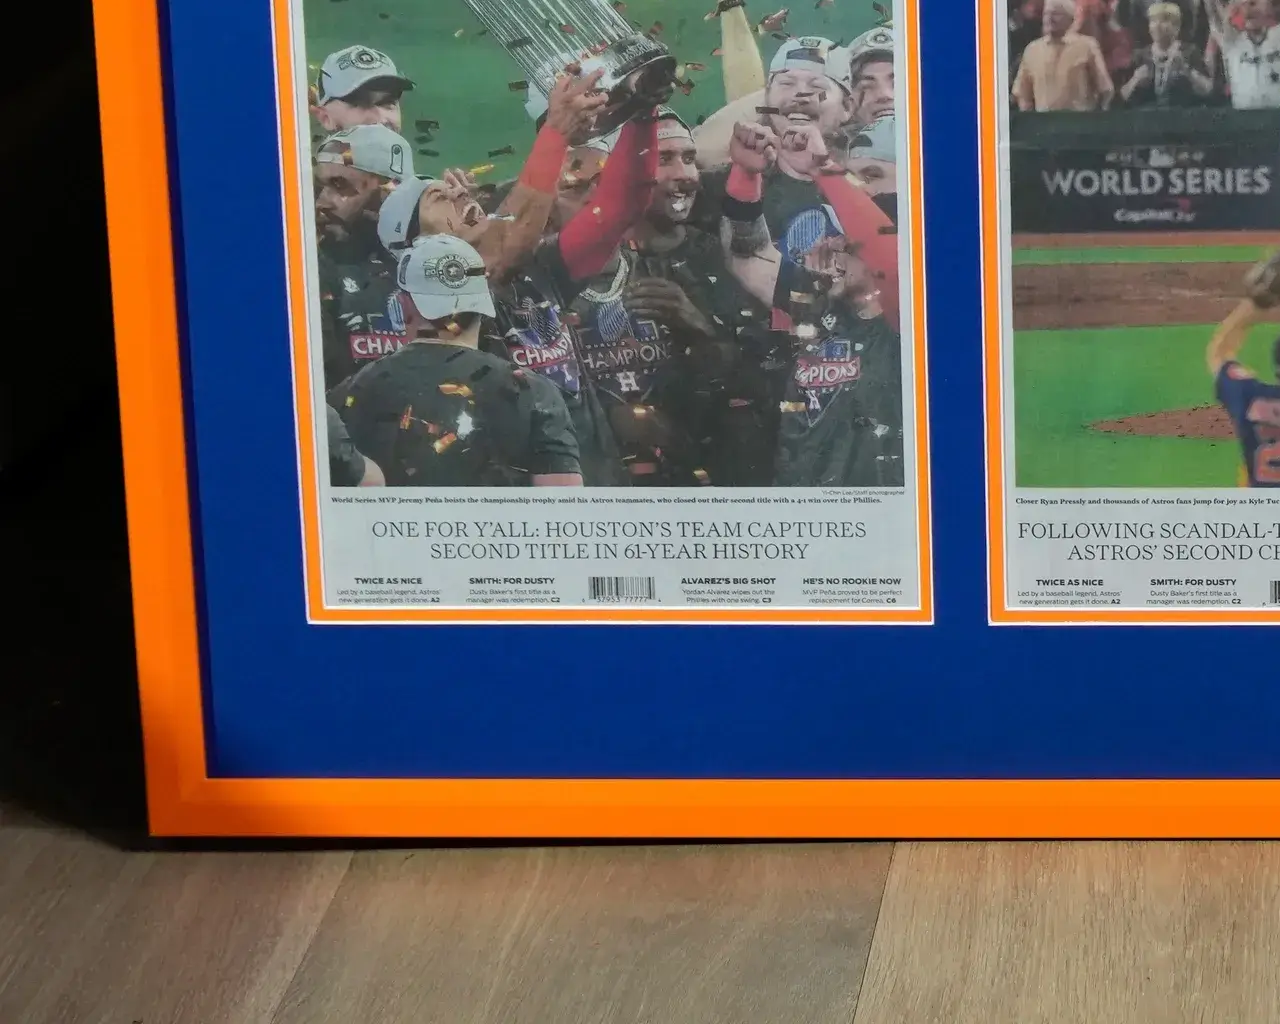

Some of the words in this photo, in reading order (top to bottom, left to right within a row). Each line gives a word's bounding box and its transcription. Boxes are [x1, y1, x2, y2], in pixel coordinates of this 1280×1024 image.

[1042, 168, 1164, 196] WORLD
[1169, 166, 1271, 195] SERIES
[1016, 497, 1038, 505] Closer
[1040, 498, 1058, 506] Ryan
[1060, 497, 1086, 506] Pressly
[1088, 497, 1101, 505] and
[1103, 497, 1140, 505] thousands
[1142, 497, 1149, 505] of
[1176, 497, 1191, 505] fans
[1193, 498, 1212, 506] jump
[1214, 497, 1224, 505] for
[1226, 498, 1237, 506] joy
[1249, 497, 1264, 506] Kyle
[372, 522, 419, 537] ONE
[425, 522, 469, 537] FOR
[474, 522, 539, 537] Y'ALL:
[545, 522, 671, 537] HOUSTON'S
[677, 522, 742, 537] TEAM
[748, 522, 866, 538] CAPTURES
[1018, 523, 1154, 538] FOLLOWING
[431, 543, 520, 559] SECOND
[525, 544, 589, 559] TITLE
[595, 544, 618, 559] IN
[624, 544, 707, 559] 61-YEAR
[712, 544, 809, 559] HISTORY
[1068, 545, 1157, 560] ASTROS'
[1163, 545, 1253, 560] SECOND
[354, 577, 384, 585] TWICE
[386, 577, 398, 585] AS
[400, 577, 422, 585] NICE
[470, 577, 501, 585] SMITH:
[504, 577, 522, 585] FOR
[524, 577, 554, 585] DUSTY
[733, 577, 748, 585] BIG
[751, 577, 776, 585] SHOT
[826, 577, 840, 585] NO
[842, 577, 877, 585] ROOKIE
[880, 577, 901, 585] NOW
[1036, 578, 1065, 587] TWICE
[1068, 578, 1080, 587] AS
[1082, 579, 1103, 587] NICE
[1150, 578, 1182, 586] SMITH:
[1185, 578, 1203, 587] FOR
[1206, 578, 1236, 587] DUSTY
